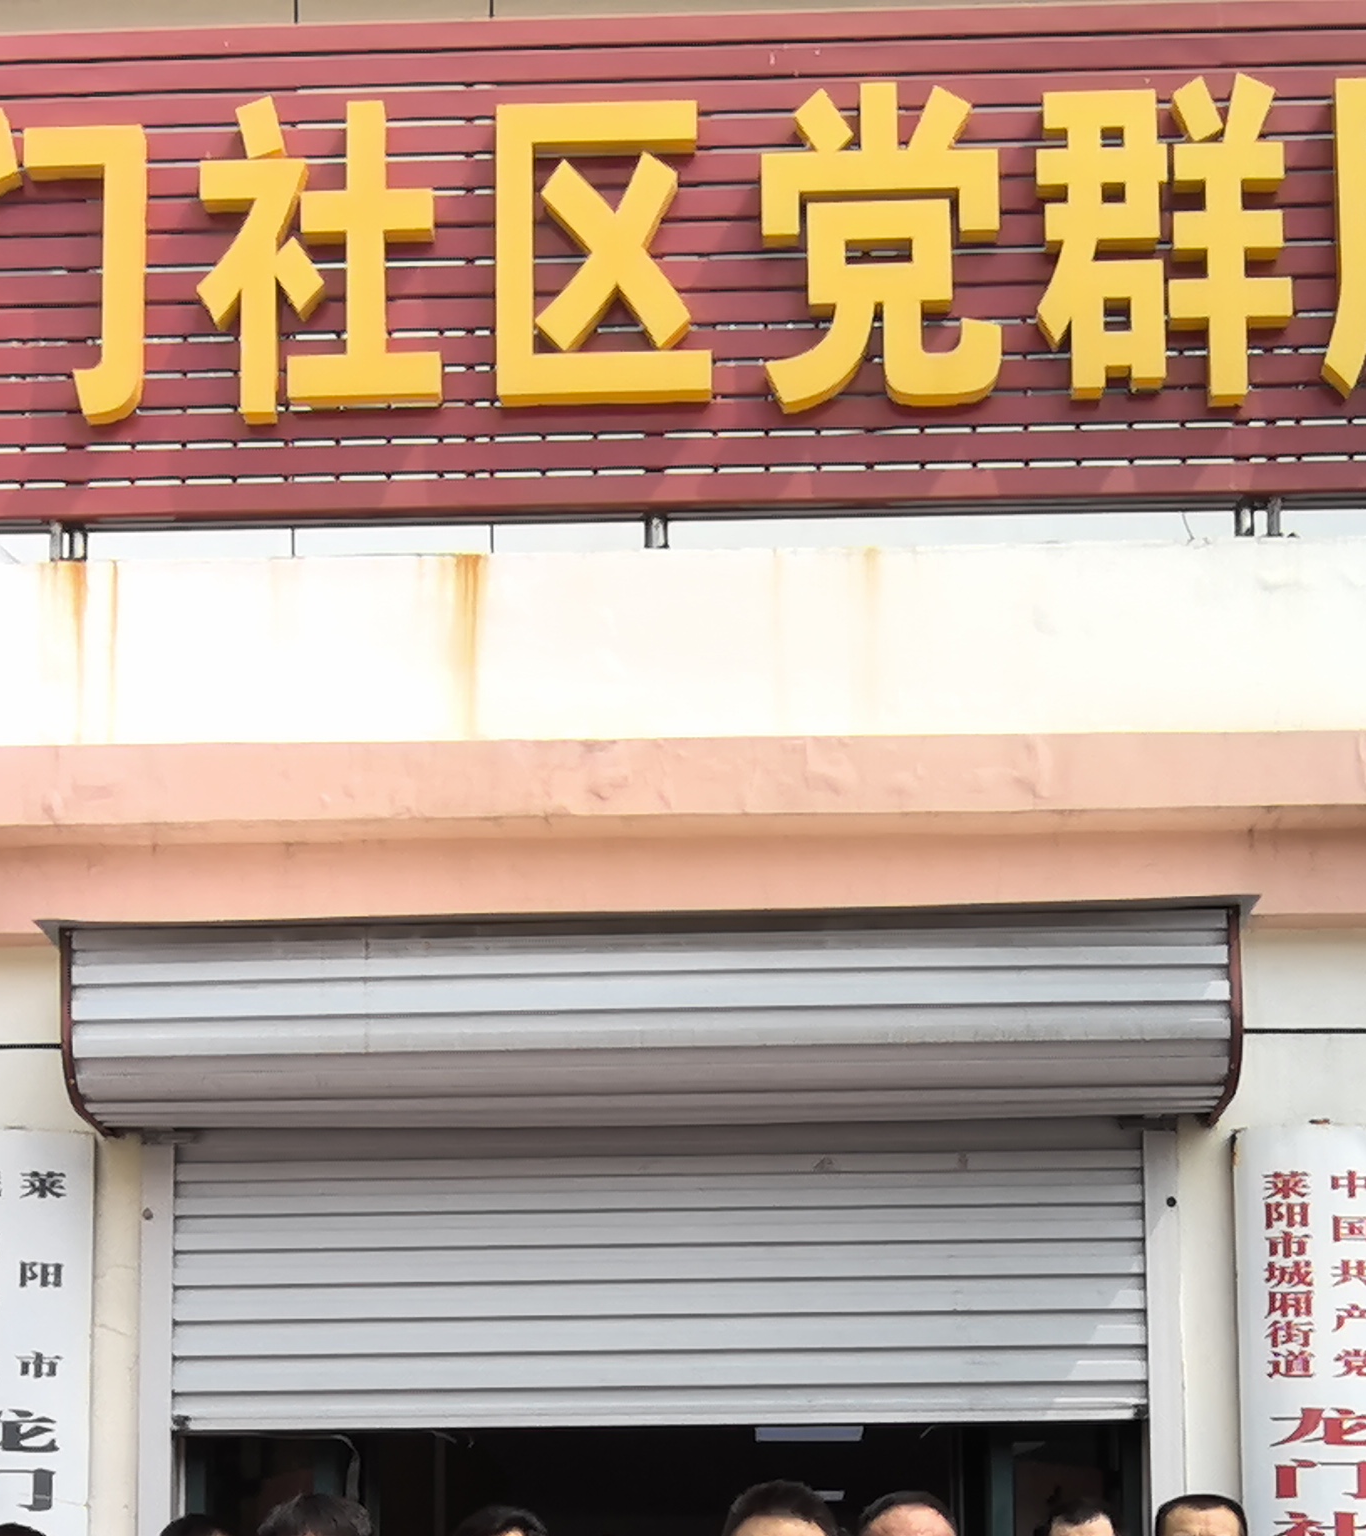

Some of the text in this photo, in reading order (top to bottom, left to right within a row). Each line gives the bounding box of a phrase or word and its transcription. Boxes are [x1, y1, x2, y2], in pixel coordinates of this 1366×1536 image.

[14, 1169, 67, 1381] 莱阳市
[1262, 1169, 1317, 1379] 莱阳市城厢街道
